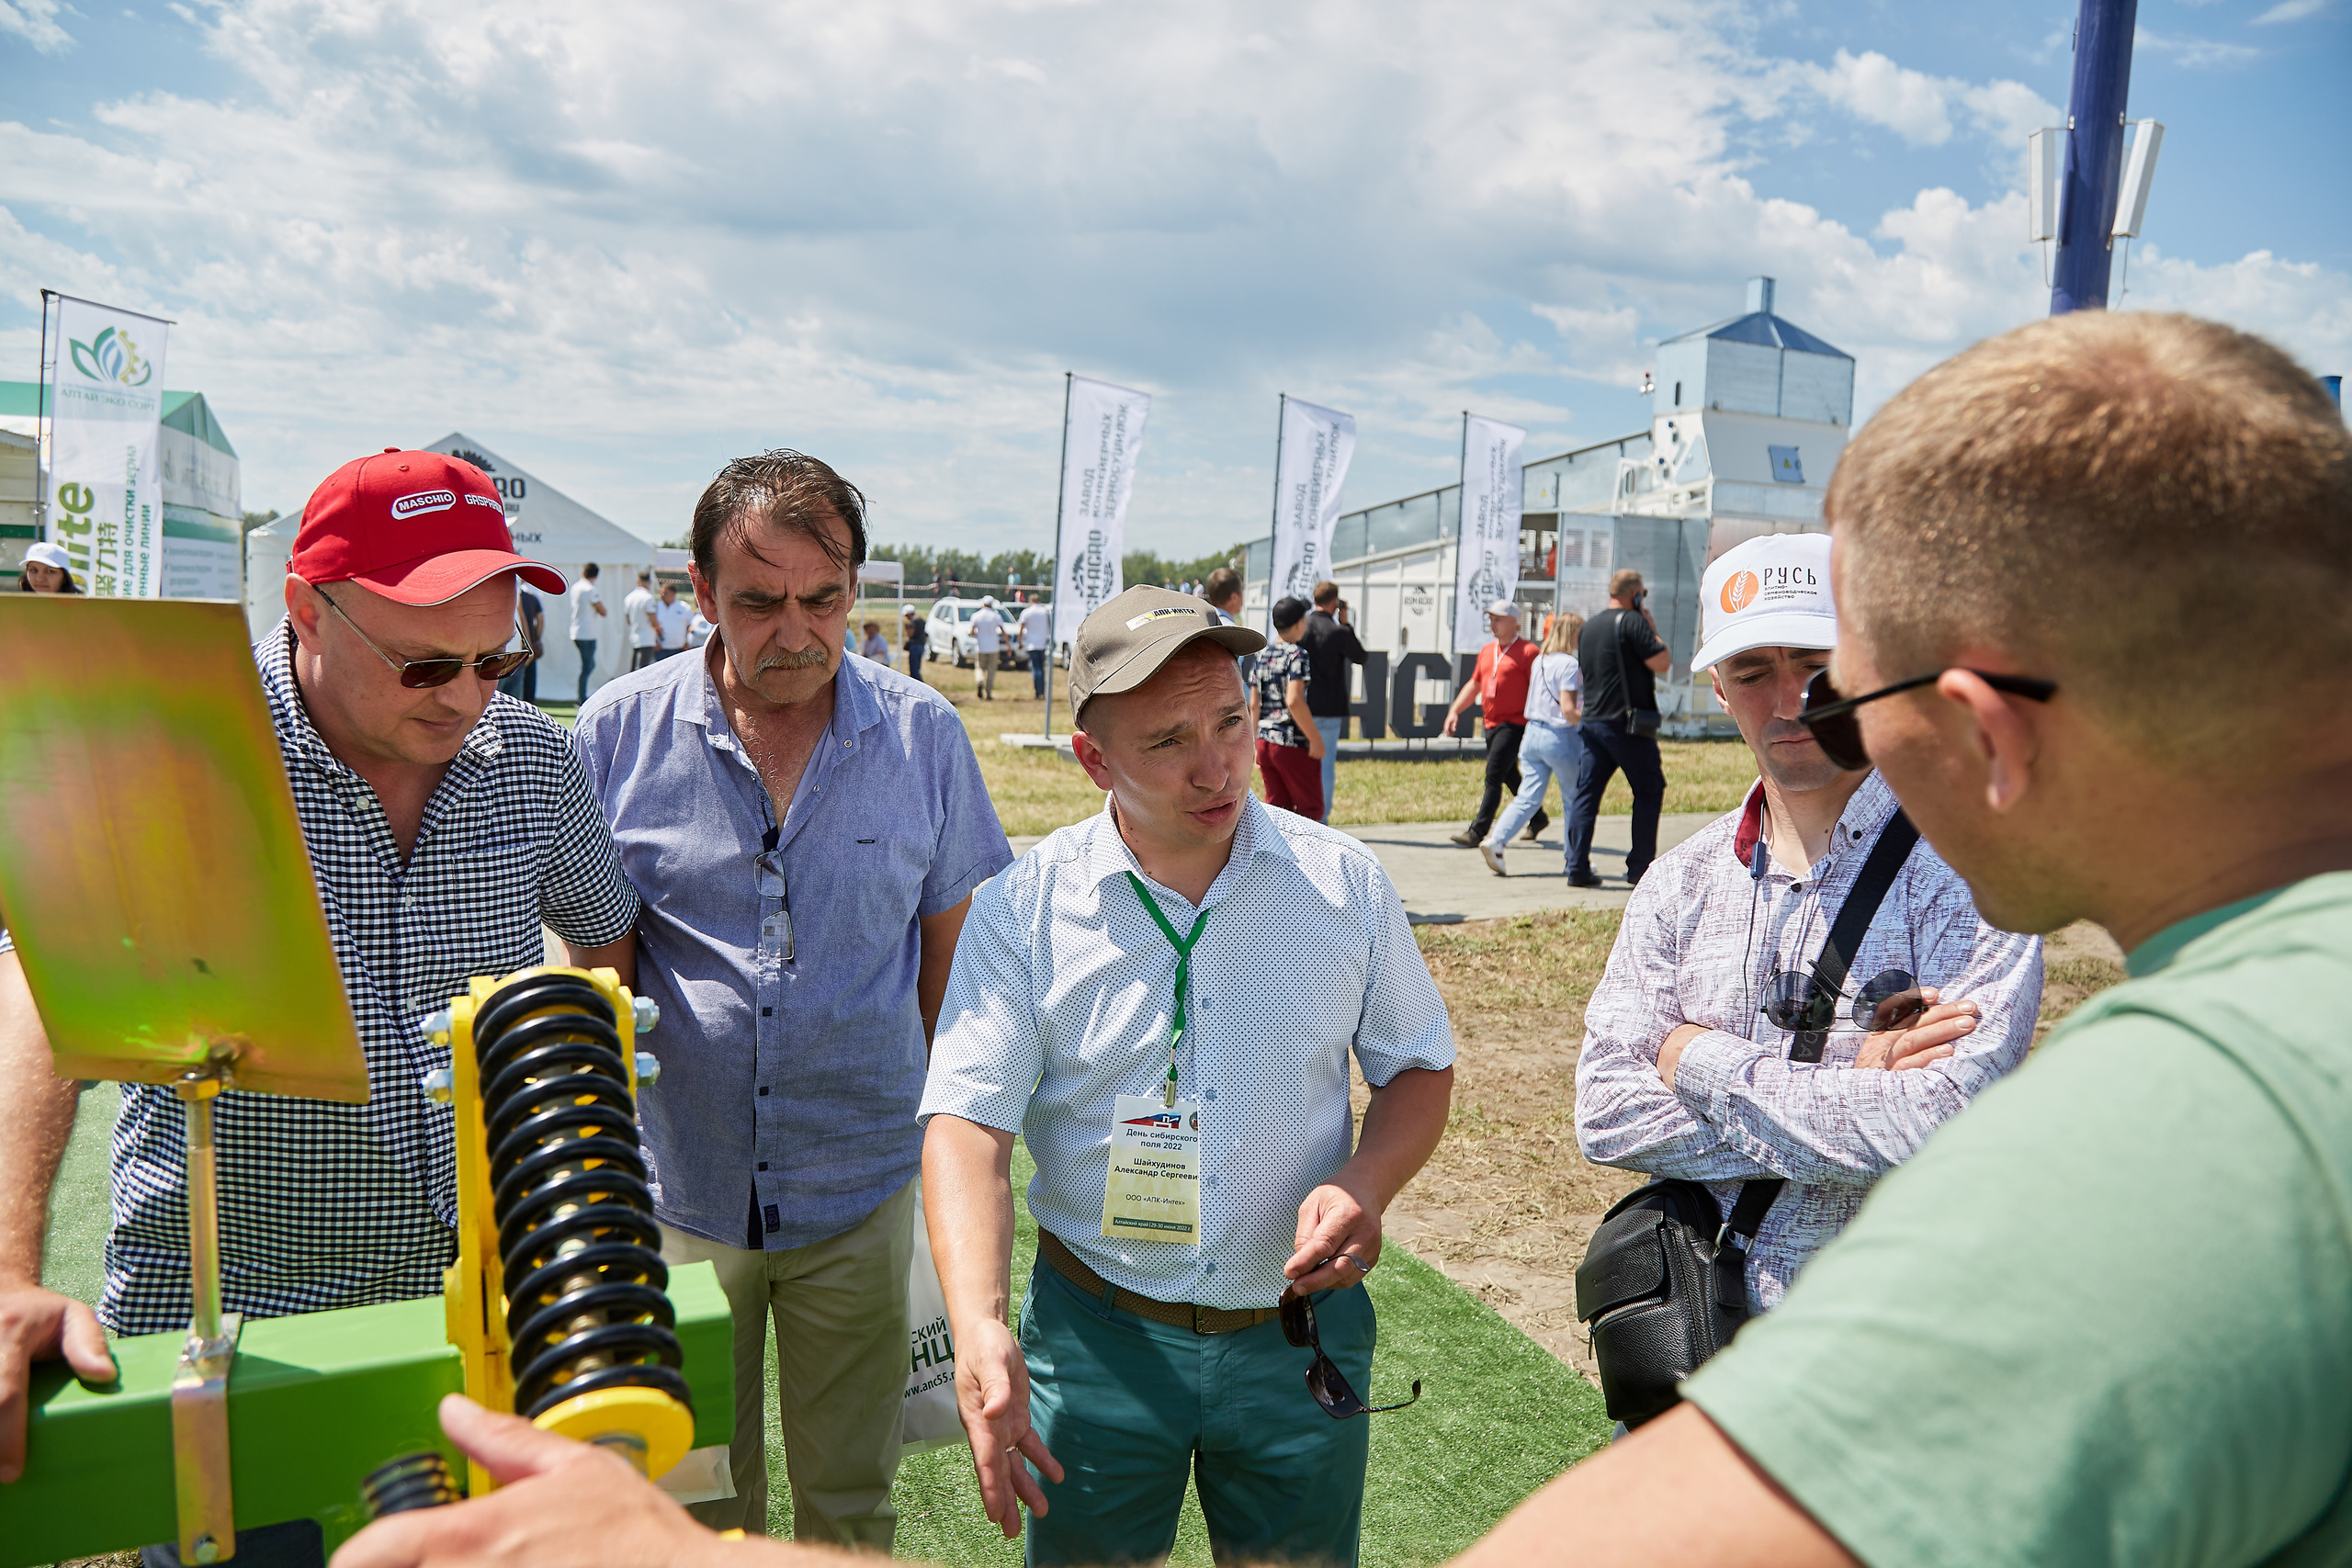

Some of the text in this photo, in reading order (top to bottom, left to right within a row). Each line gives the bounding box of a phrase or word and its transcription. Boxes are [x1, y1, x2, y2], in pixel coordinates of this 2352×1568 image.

[61, 389, 98, 402] АЛТАЙ
[102, 396, 126, 407] ЭКО
[129, 400, 155, 412] СОРТ
[127, 446, 140, 487] зерна
[492, 477, 526, 499] RO
[1080, 468, 1095, 516] ЗАВОД
[398, 493, 452, 511] MASCHIO
[1294, 483, 1307, 530] ЗАВОД
[125, 490, 137, 547] очистки
[123, 550, 137, 577] для
[139, 504, 152, 597] енные линии
[1087, 530, 1102, 616] SM-AGRO
[1764, 567, 1816, 586] РУСЬ
[1125, 1128, 1198, 1143] День сибирского
[1163, 1142, 1182, 1150] 2022
[1114, 1165, 1198, 1180] Александр Сергееви
[1134, 1157, 1186, 1169] Шайхудинов
[910, 1333, 956, 1375] НЦ
[904, 1371, 956, 1398] ww.anc55.r
